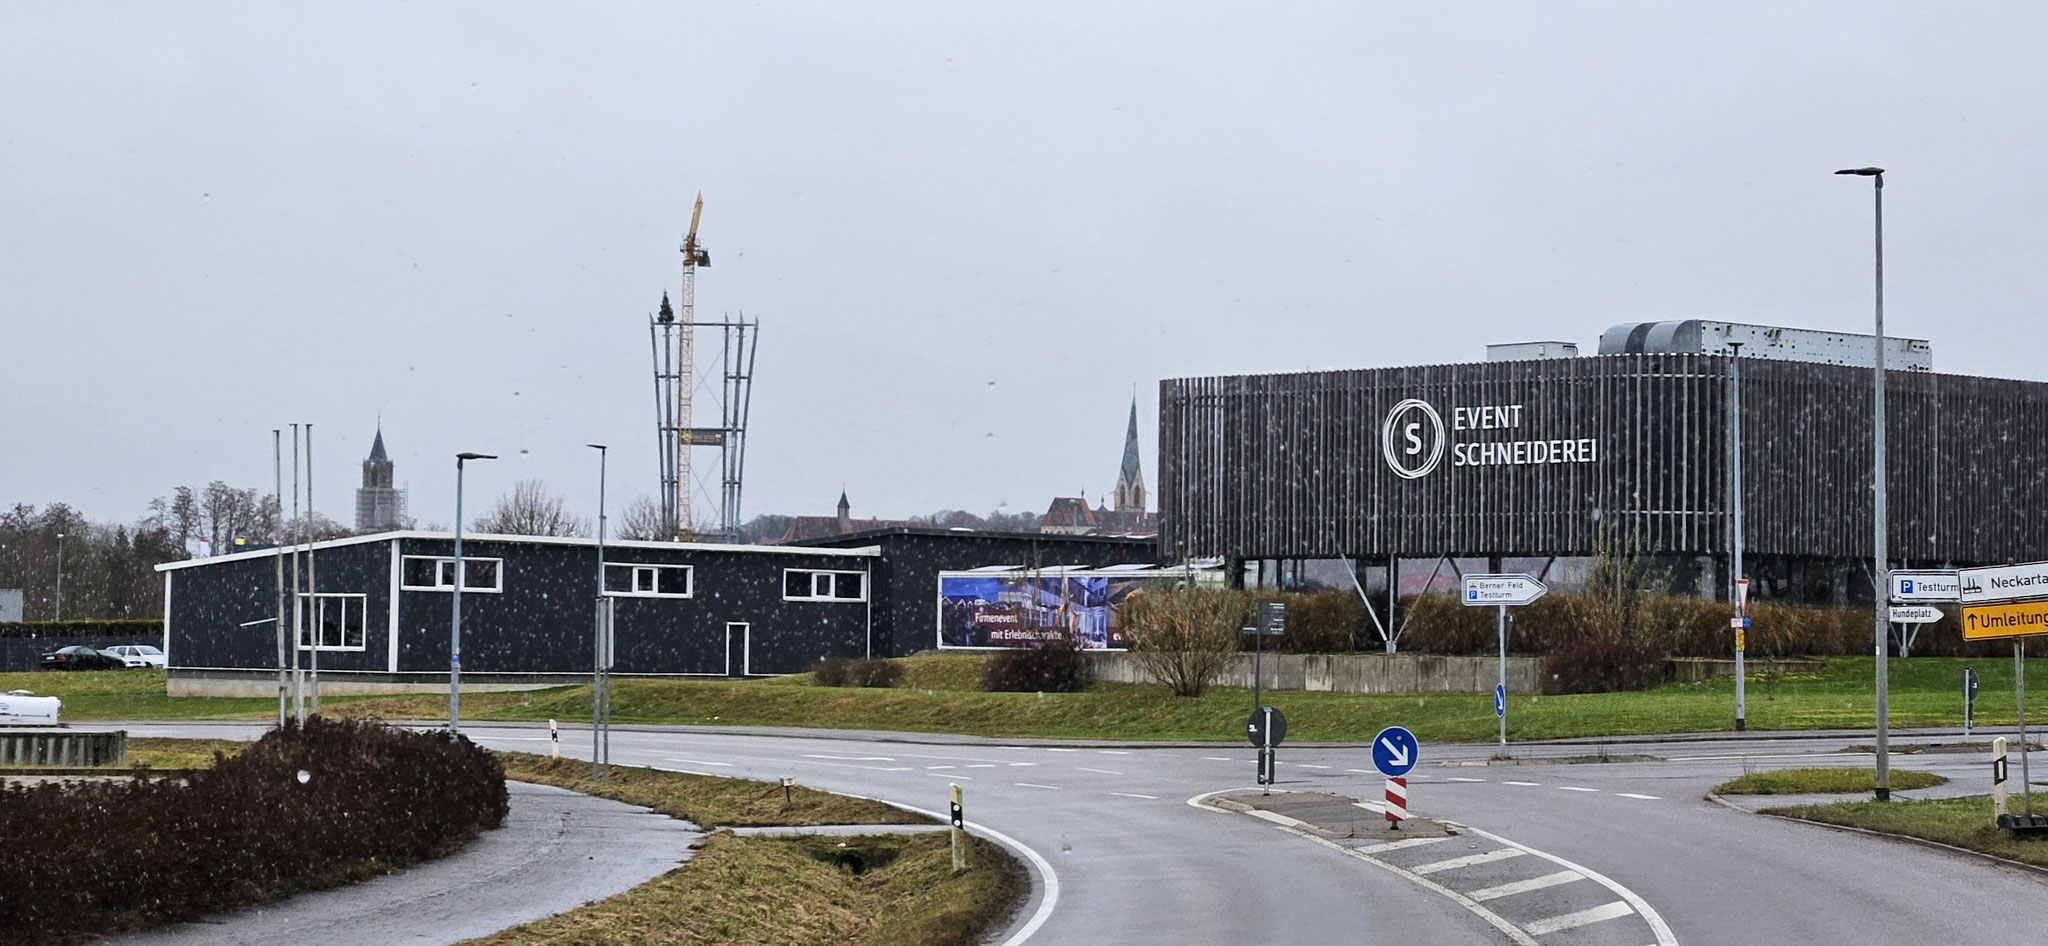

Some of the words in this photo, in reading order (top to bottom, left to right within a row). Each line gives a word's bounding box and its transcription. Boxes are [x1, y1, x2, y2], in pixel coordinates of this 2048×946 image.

[1454, 405, 1523, 430] EVENT
[1405, 423, 1422, 455] S
[1454, 438, 1597, 467] SCHNEIDEREI
[1507, 581, 1523, 589] Feld
[1917, 582, 1960, 592] Testturm
[1480, 591, 1512, 599] Testturm
[1892, 609, 1932, 620] Hundeplatz
[991, 629, 1003, 640] mit
